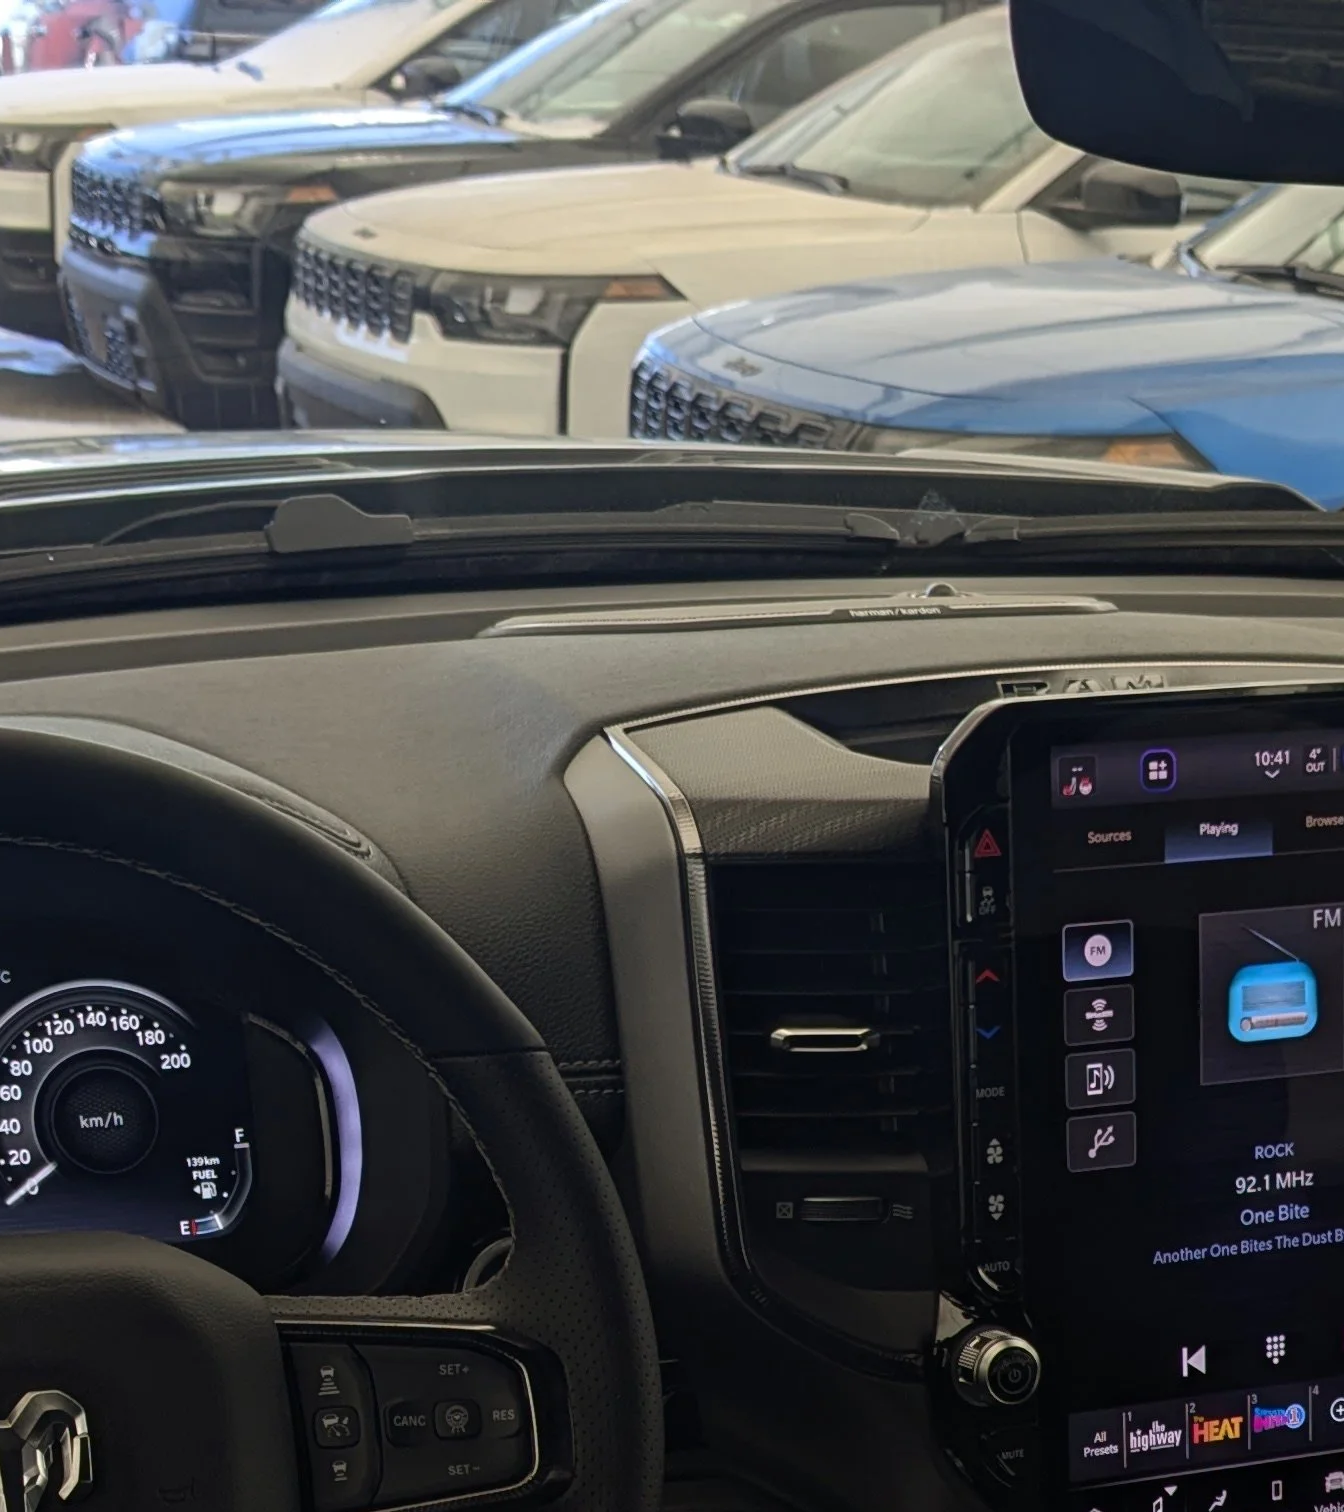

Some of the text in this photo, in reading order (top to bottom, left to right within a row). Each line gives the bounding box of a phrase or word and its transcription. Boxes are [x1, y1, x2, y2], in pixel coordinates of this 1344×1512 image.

[996, 674, 1168, 698] RAM
[1255, 750, 1290, 767] 10:41
[1305, 762, 1326, 773] OUT
[1199, 821, 1239, 838] Playing
[1305, 814, 1344, 828] Browse
[1087, 830, 1132, 845] Sources
[1312, 908, 1343, 930] FM
[1089, 944, 1107, 957] FM
[44, 1017, 75, 1037] 120
[76, 1011, 107, 1028] 140
[109, 1014, 141, 1032] 160
[23, 1038, 54, 1055] 100
[135, 1029, 166, 1047] 180
[9, 1059, 33, 1078] 80
[160, 1052, 192, 1071] 200
[975, 1085, 1006, 1100] MODE
[79, 1112, 125, 1130] km/h
[234, 1127, 246, 1143] F
[8, 1148, 31, 1167] 20
[1254, 1142, 1295, 1160] ROCK
[192, 1169, 218, 1180] FUEL
[1235, 1170, 1314, 1194] 92.1 MHz
[1240, 1203, 1310, 1226] One Bite
[179, 1220, 190, 1236] E
[1153, 1245, 1208, 1265] Another
[1210, 1243, 1238, 1258] One
[1240, 1237, 1272, 1253] Bites
[1275, 1235, 1300, 1250] The
[1302, 1230, 1333, 1246] Dust
[983, 1260, 1010, 1273] AUTO
[1251, 1393, 1258, 1405] 3
[1312, 1385, 1319, 1396] 4
[492, 1409, 515, 1422] RES
[1127, 1411, 1132, 1422] 1
[1189, 1402, 1196, 1414] 2
[1290, 1407, 1300, 1425] 1
[393, 1415, 426, 1427] CANC
[1152, 1420, 1165, 1433] the
[1094, 1431, 1107, 1444] All
[1193, 1416, 1244, 1444] HEAT
[1129, 1429, 1182, 1452] highway
[1083, 1444, 1119, 1458] Presets
